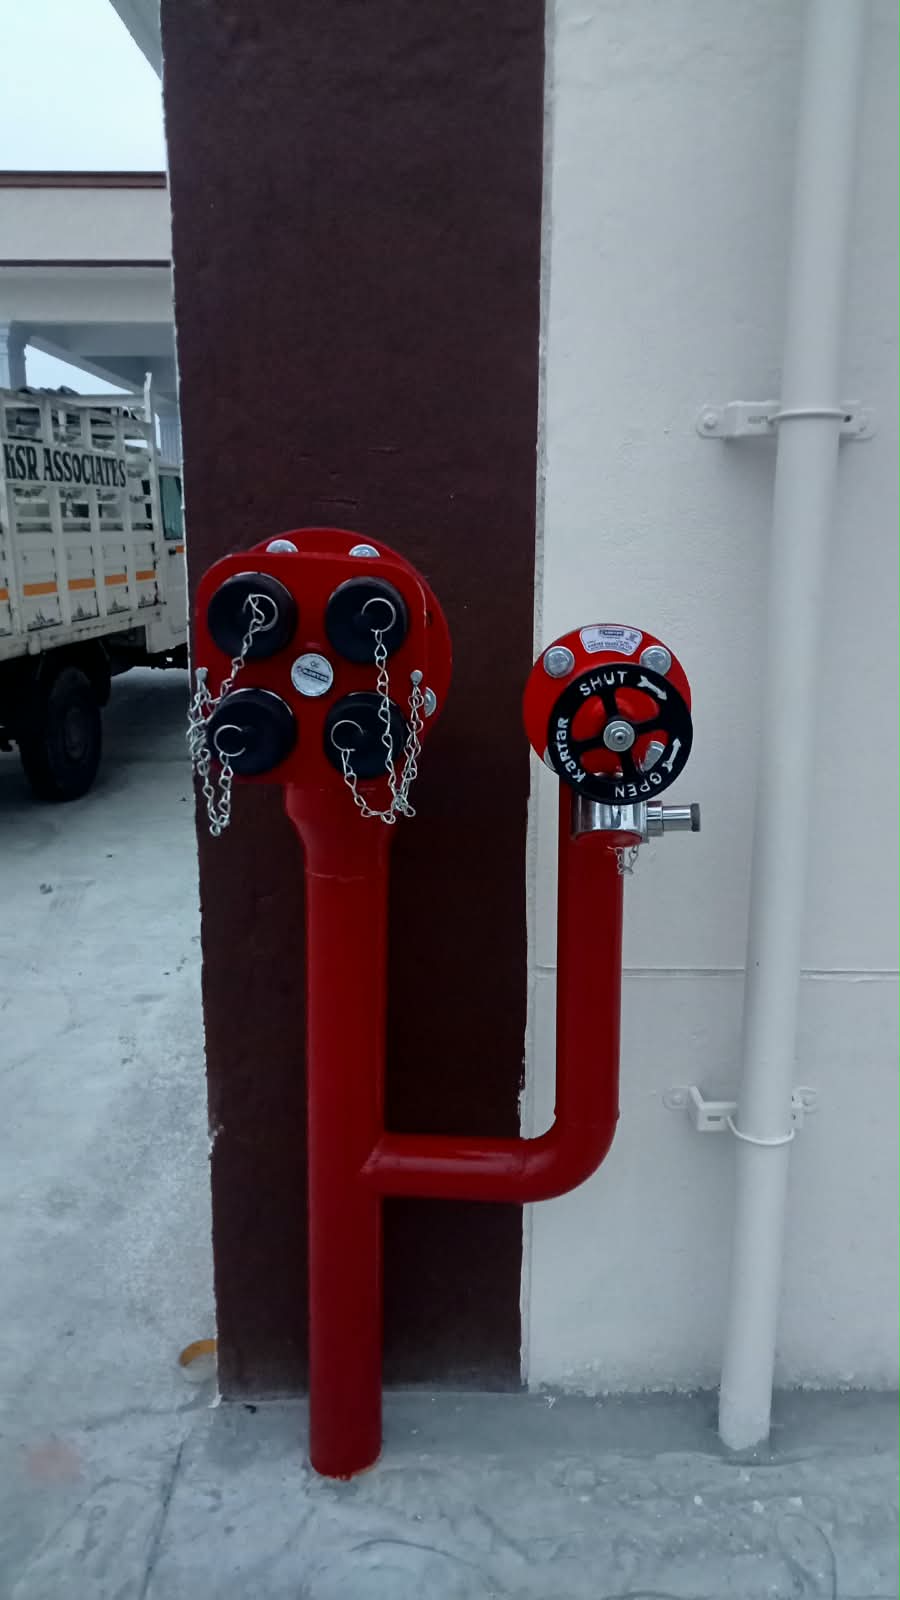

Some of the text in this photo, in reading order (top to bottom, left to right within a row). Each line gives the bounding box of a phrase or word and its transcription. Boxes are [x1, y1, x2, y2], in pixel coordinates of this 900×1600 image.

[4, 443, 126, 487] KSR ASSOCIATES
[579, 671, 627, 696] SHUT
[615, 772, 662, 798] OPEN
